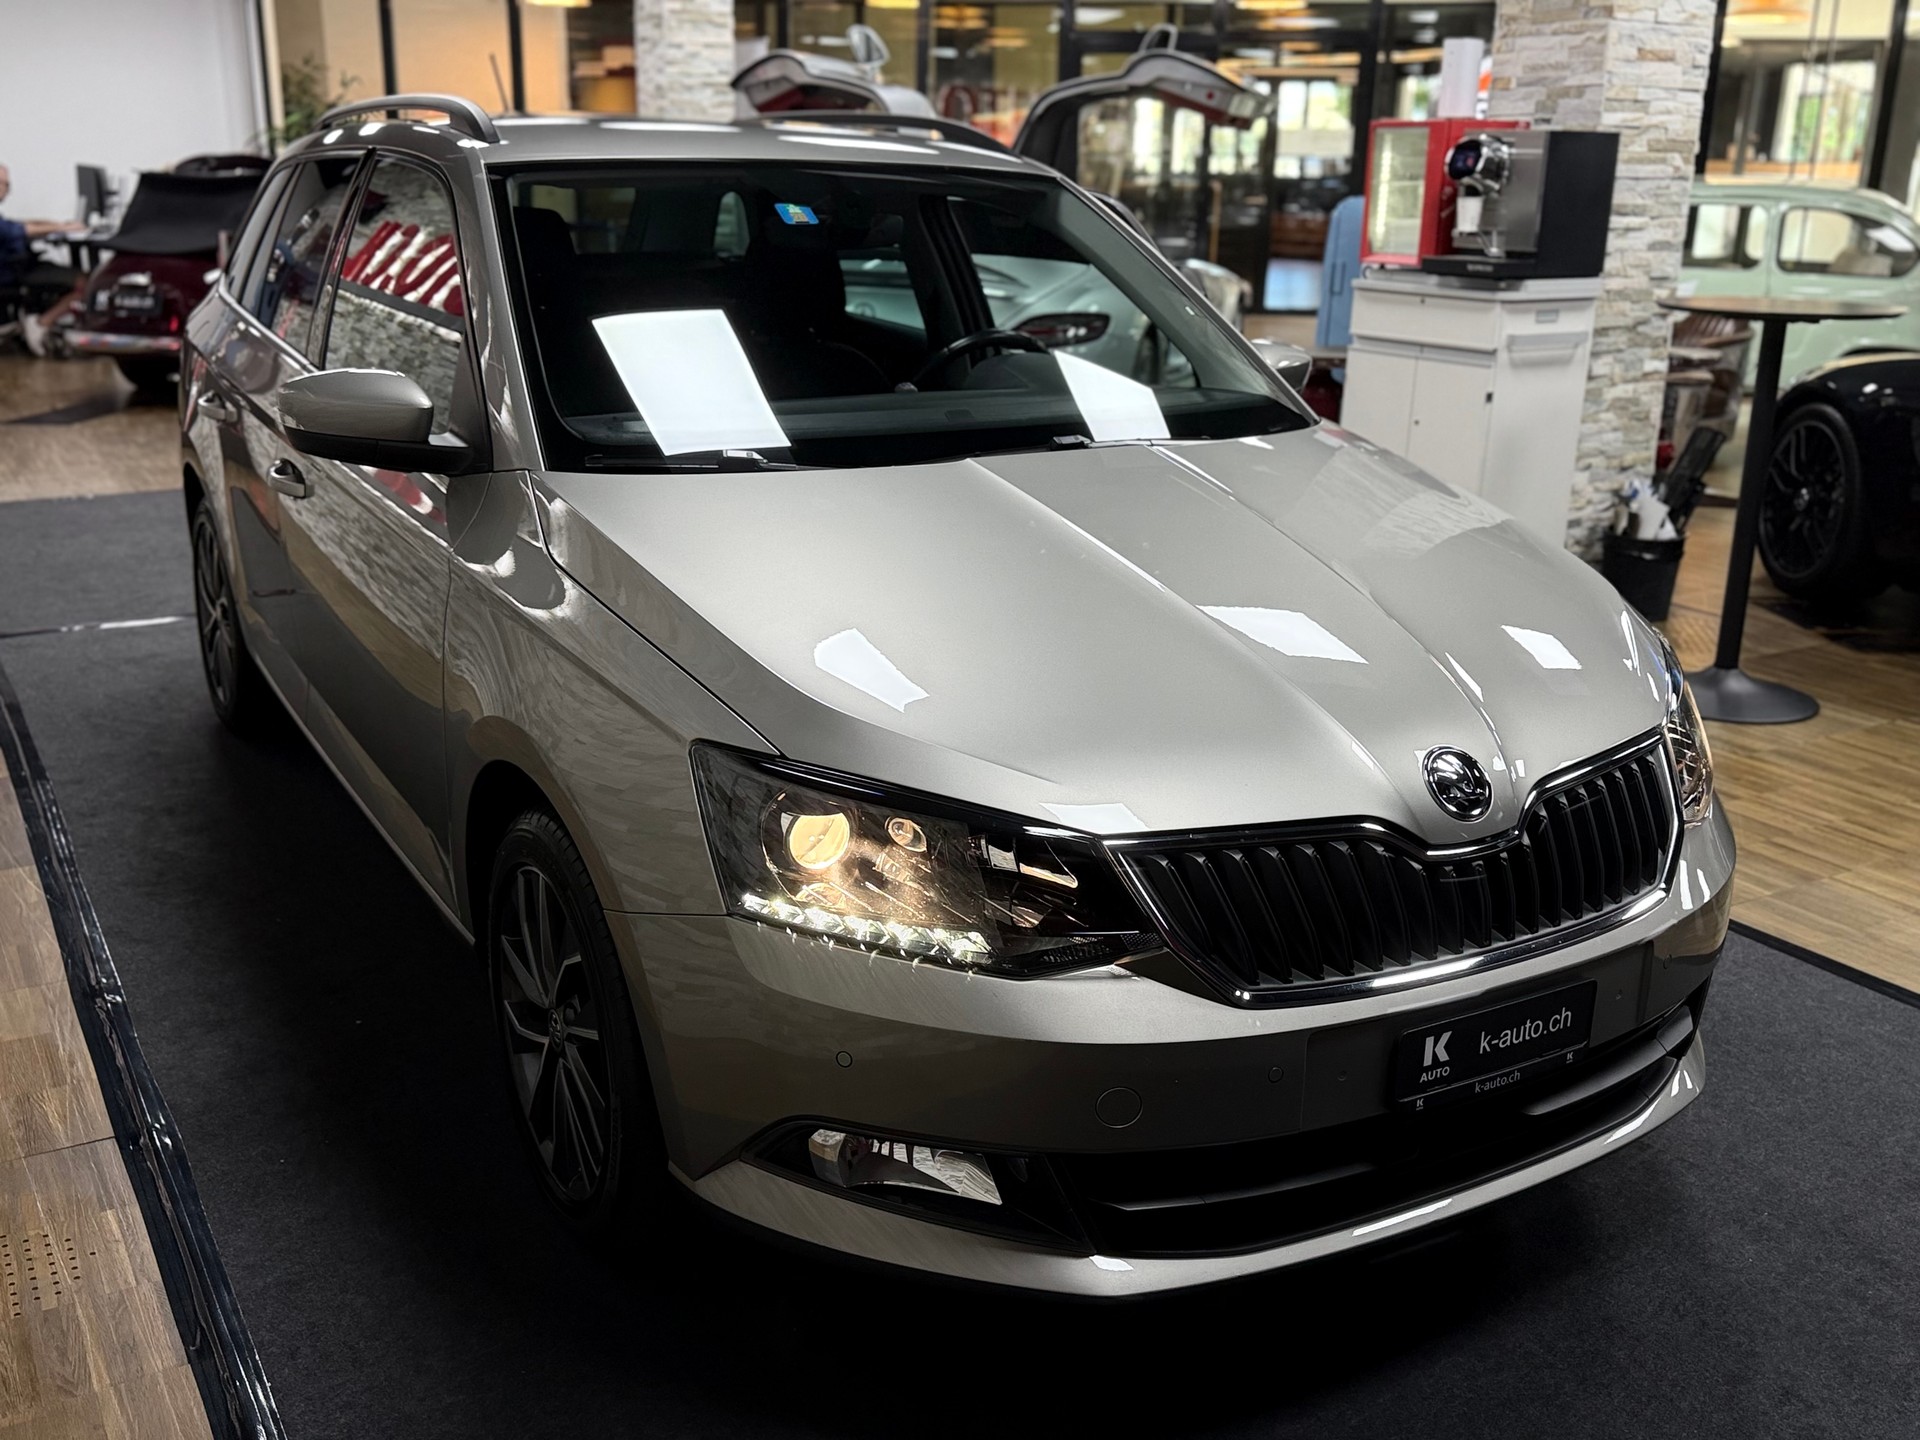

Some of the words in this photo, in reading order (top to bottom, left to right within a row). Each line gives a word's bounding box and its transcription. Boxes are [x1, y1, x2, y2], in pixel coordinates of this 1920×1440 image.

[1480, 1007, 1572, 1054] k-auto.ch
[1423, 1031, 1452, 1067] K
[1420, 1066, 1450, 1083] AUTO
[1475, 1070, 1521, 1094] k-auto.ch
